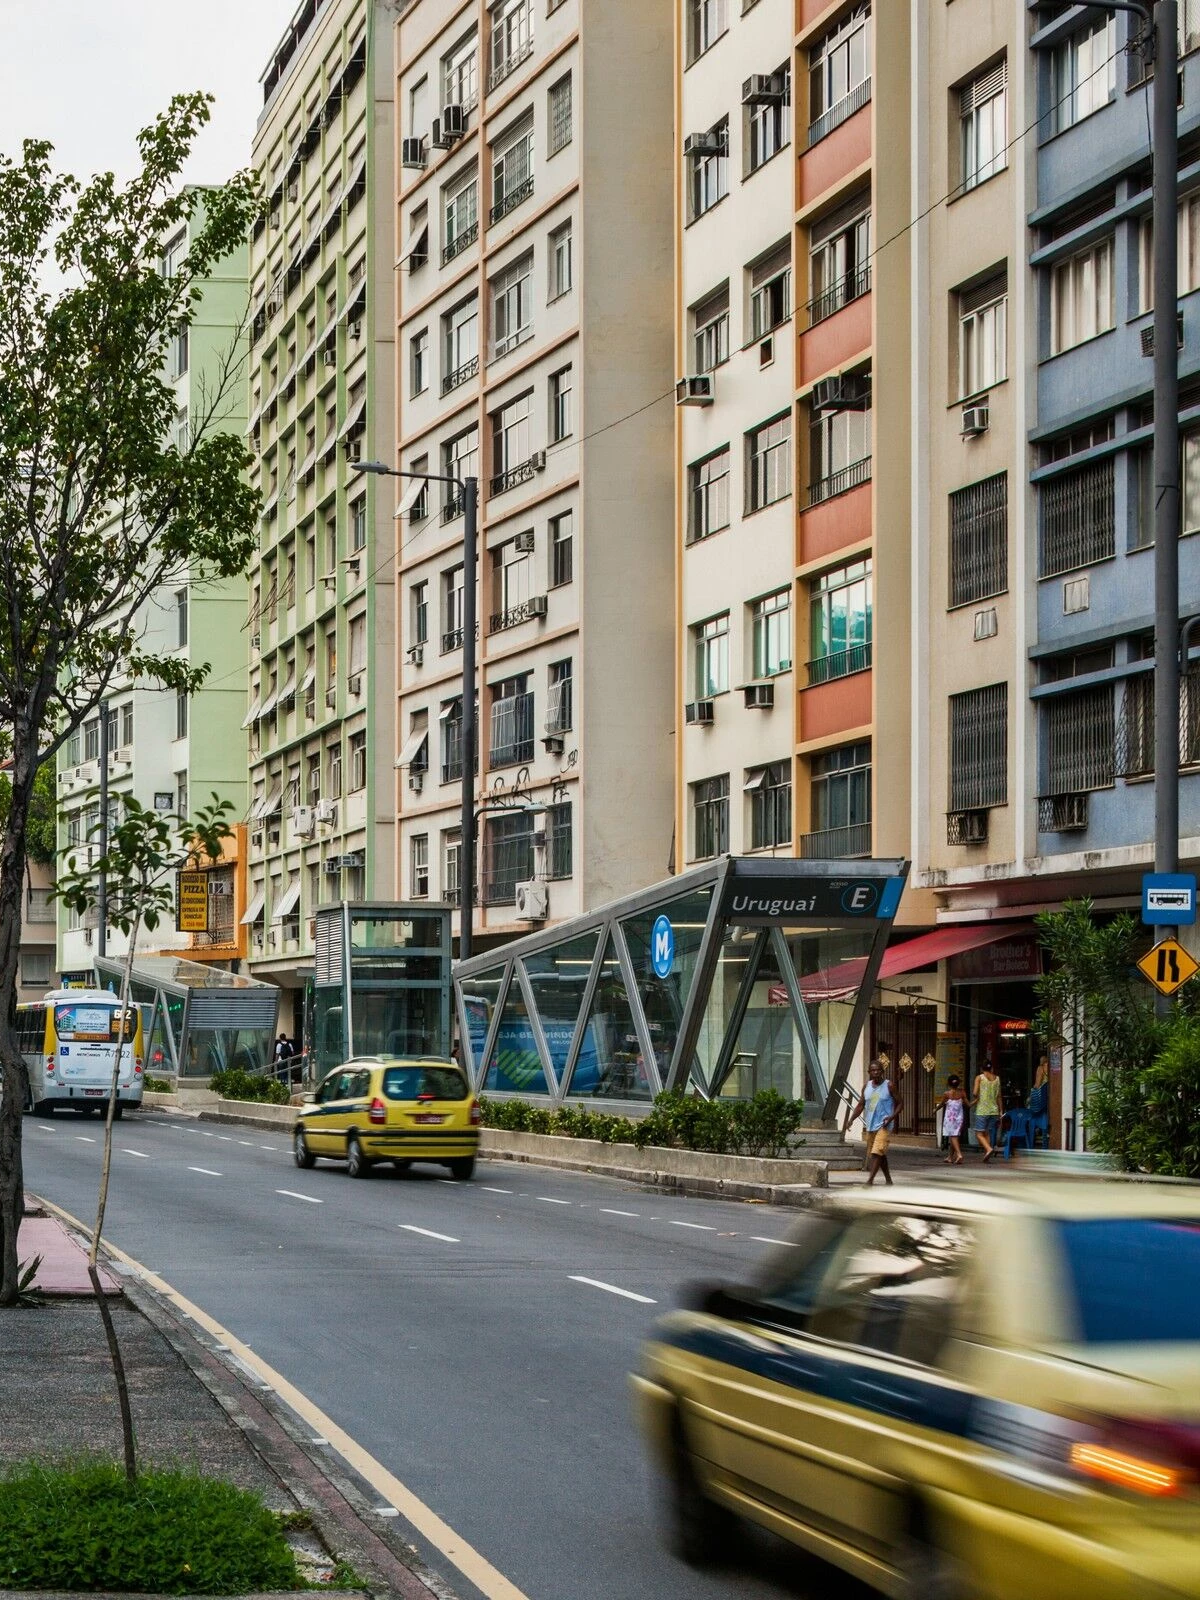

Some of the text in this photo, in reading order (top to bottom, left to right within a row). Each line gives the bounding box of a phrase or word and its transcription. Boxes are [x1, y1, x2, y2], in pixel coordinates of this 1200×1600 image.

[184, 885, 205, 894] PIZZA
[851, 887, 869, 908] E
[732, 896, 817, 915] Uruguai
[114, 1009, 131, 1019] 62
[105, 1049, 130, 1059] A722
